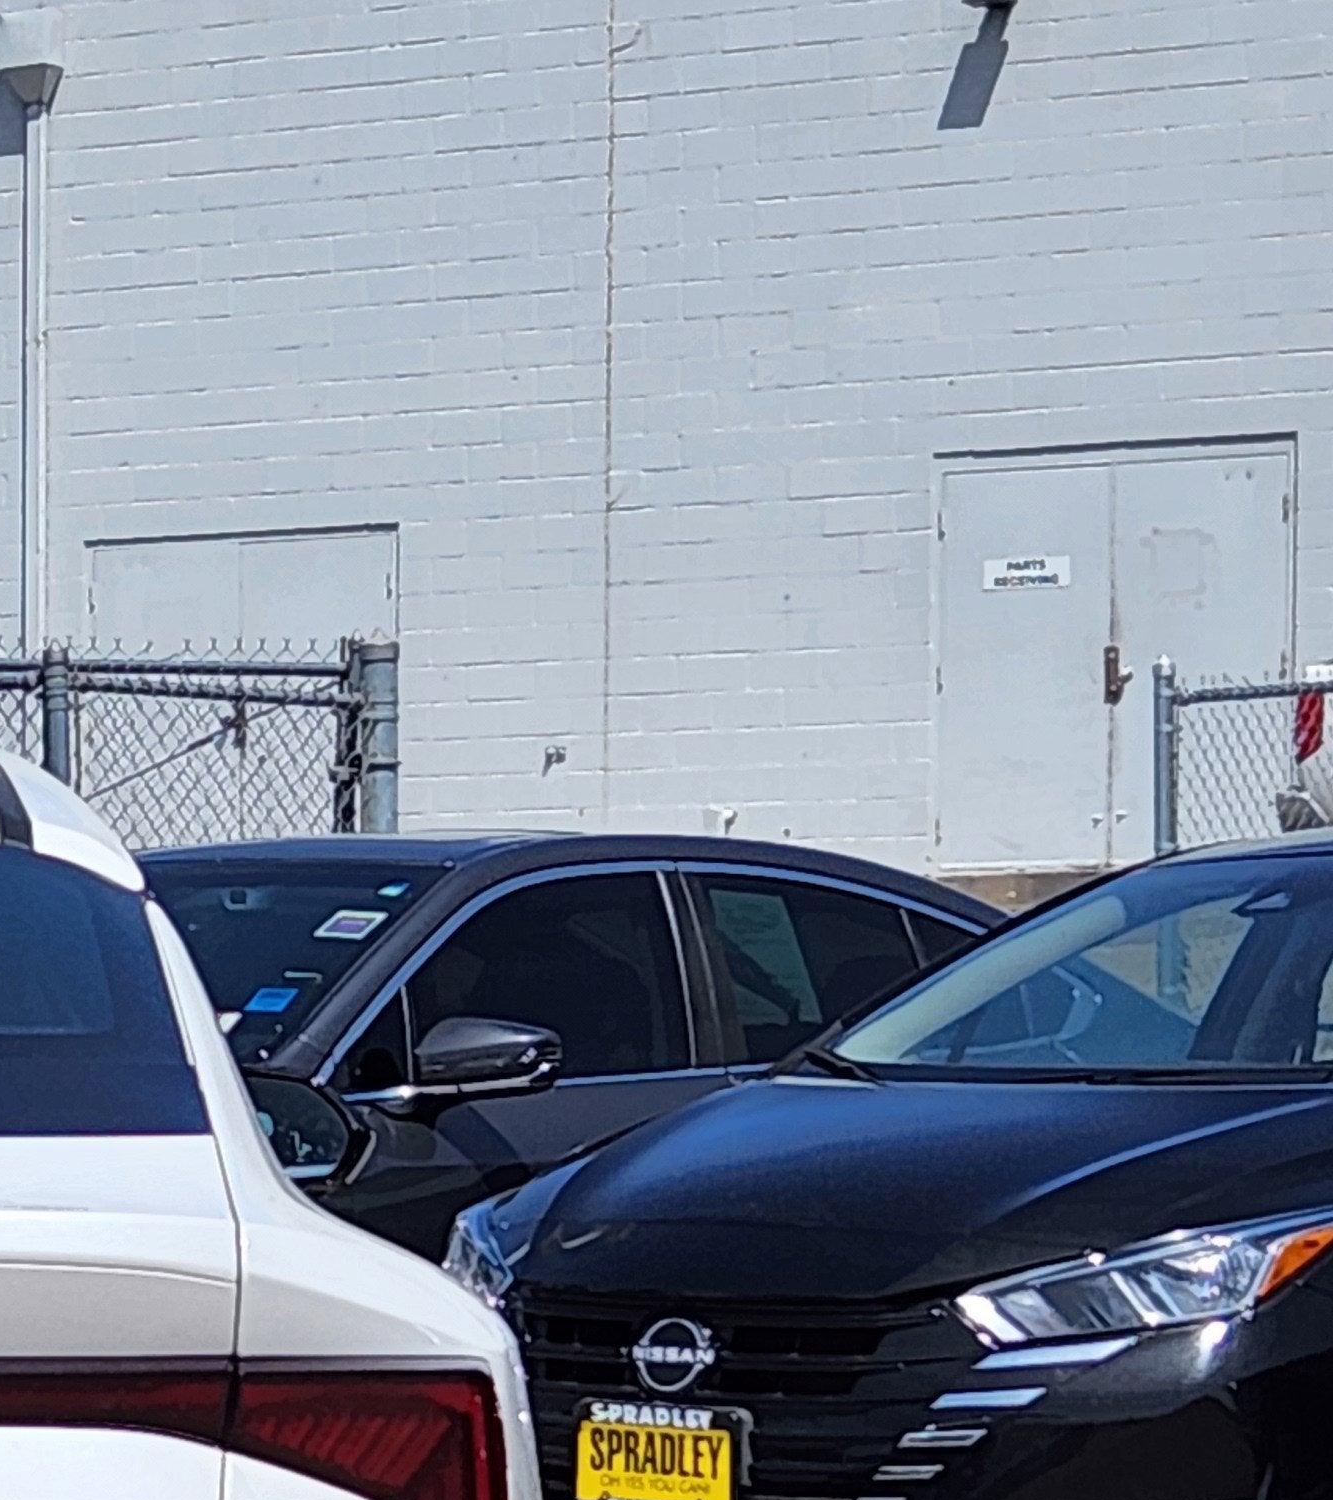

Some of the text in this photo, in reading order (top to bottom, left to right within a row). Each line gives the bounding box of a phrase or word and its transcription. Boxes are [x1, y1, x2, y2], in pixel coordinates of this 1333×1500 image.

[632, 1345, 716, 1365] NISSAN
[590, 1402, 714, 1430] SPRADLEY
[590, 1427, 724, 1480] SPRADLEY
